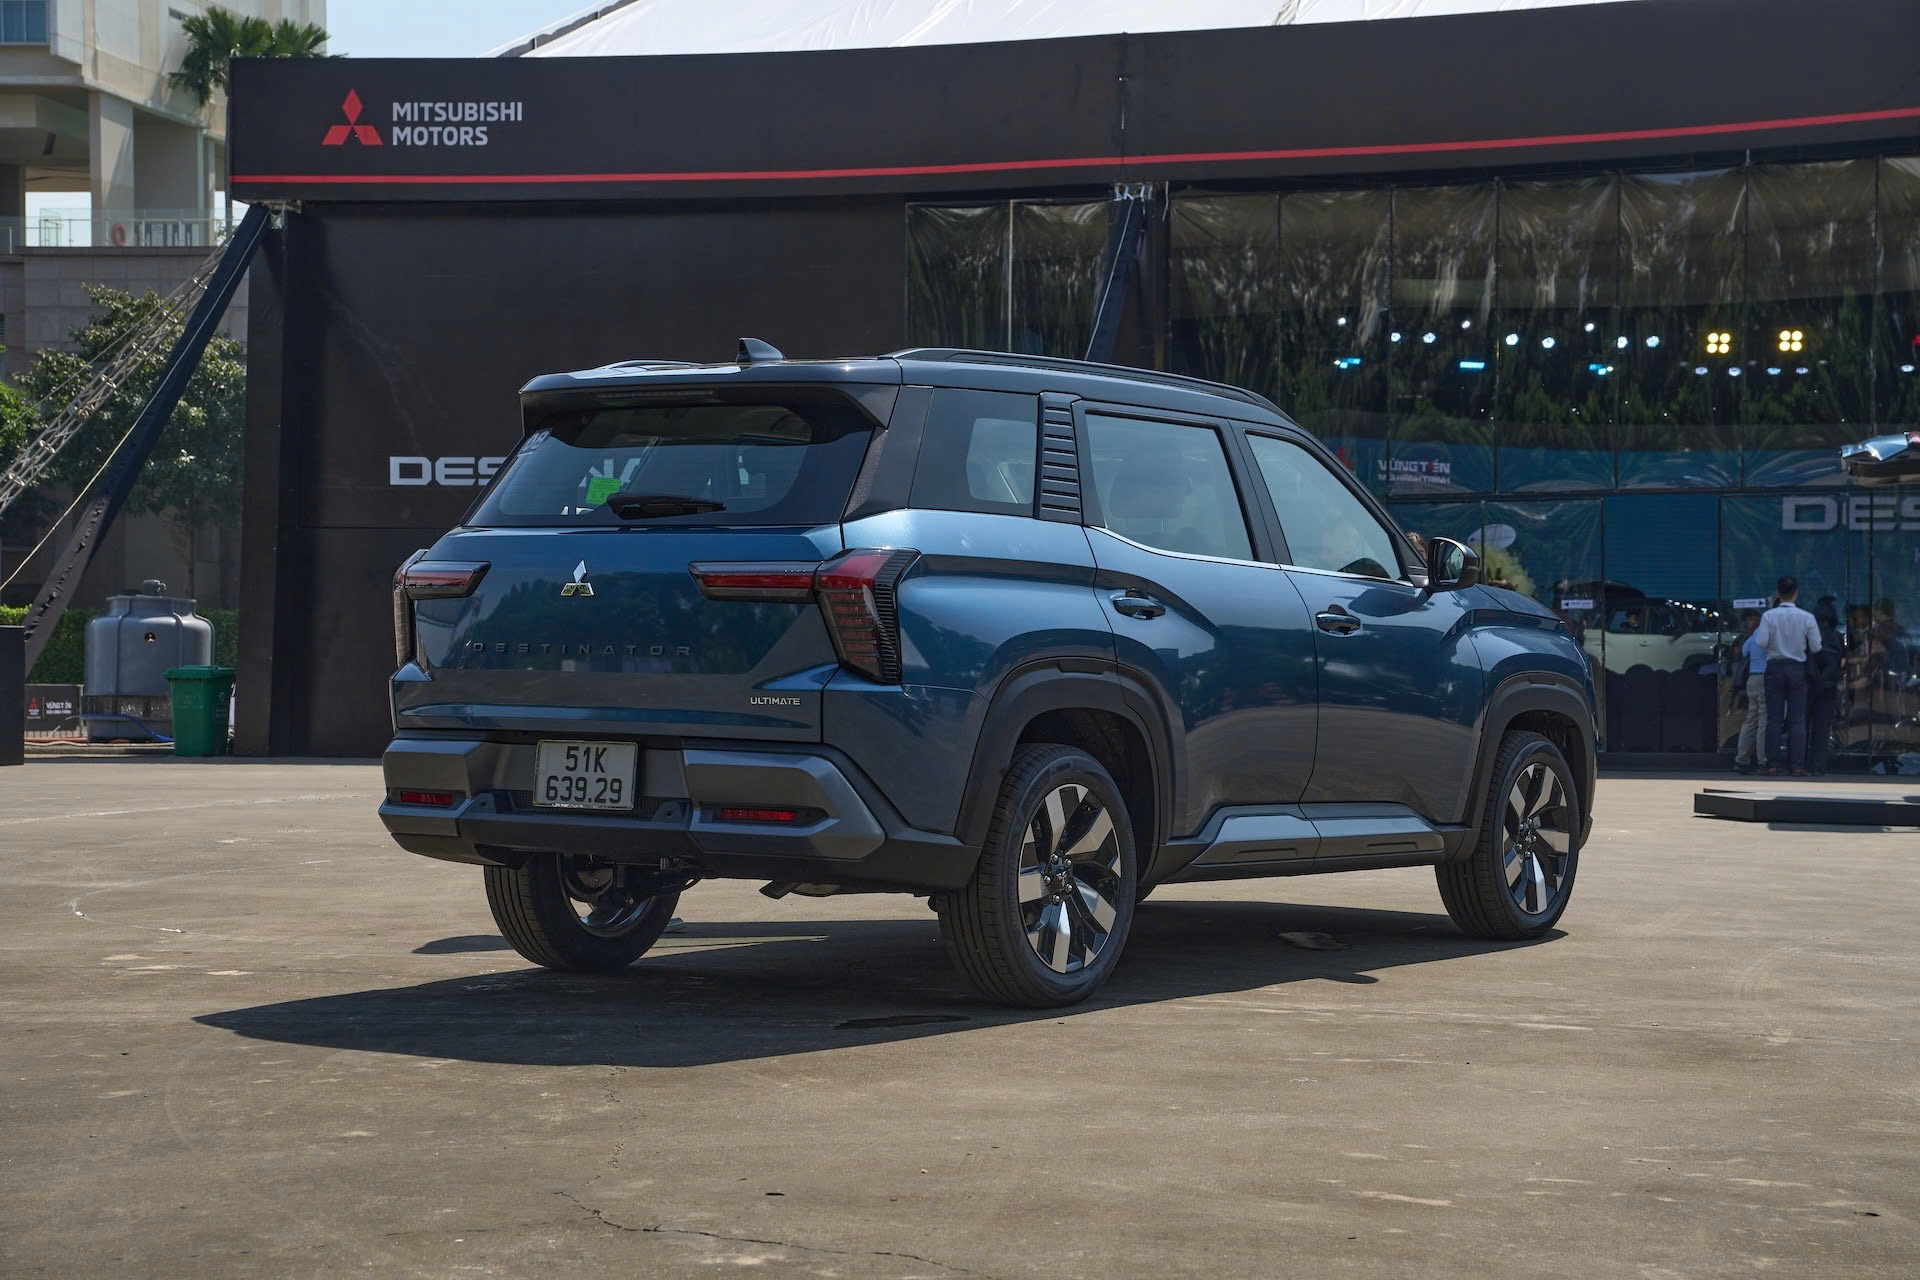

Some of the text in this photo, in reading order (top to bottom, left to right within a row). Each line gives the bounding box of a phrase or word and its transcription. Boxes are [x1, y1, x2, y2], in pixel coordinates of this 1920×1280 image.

[392, 101, 523, 122] MITSUBISHI
[392, 126, 488, 146] MOTORS
[472, 642, 691, 656] DESTINATOR
[750, 697, 801, 705] ULTIMATE
[565, 746, 608, 773] 51K
[545, 775, 623, 804] 639.29
